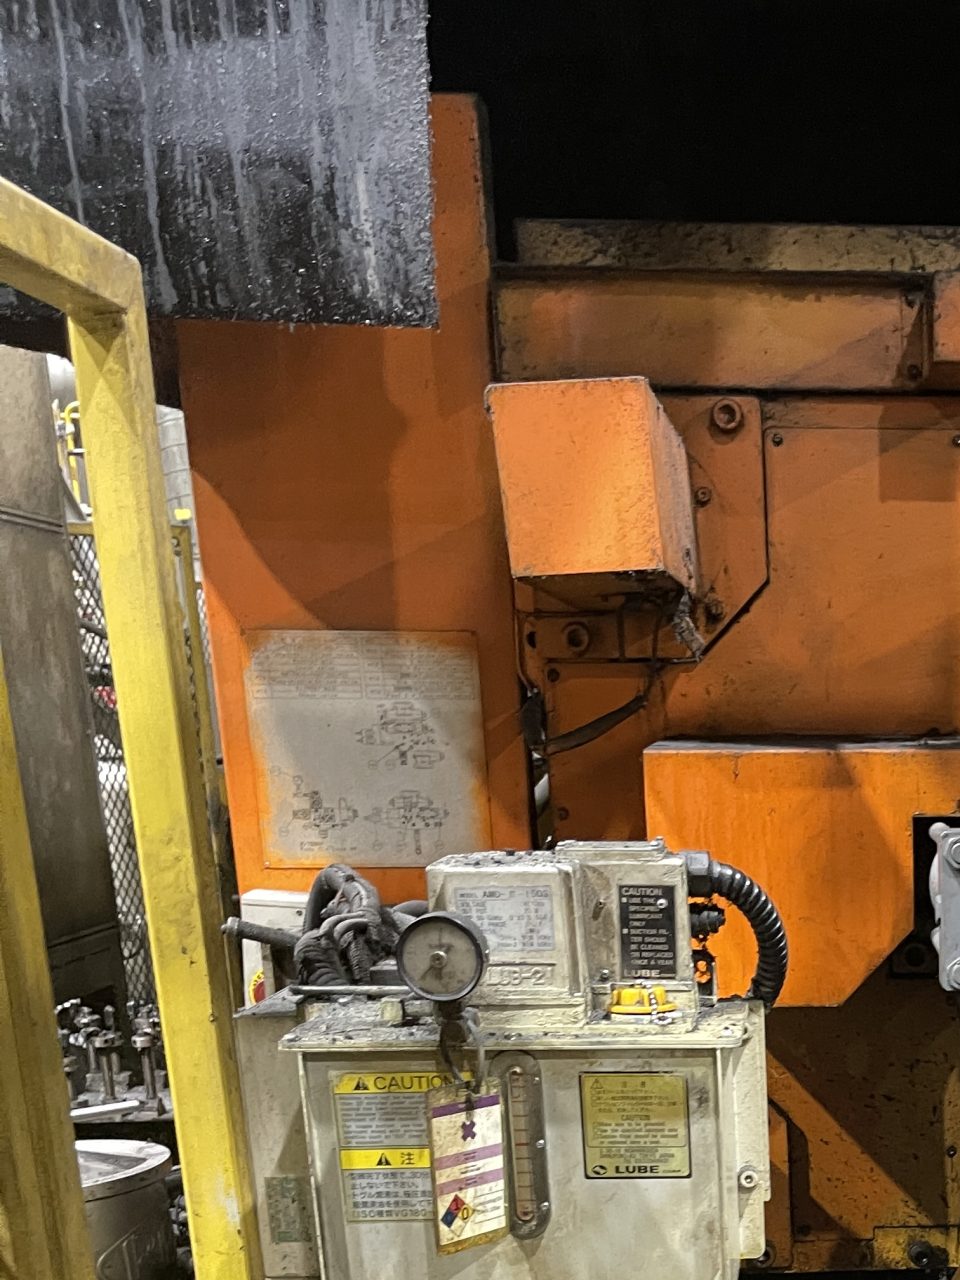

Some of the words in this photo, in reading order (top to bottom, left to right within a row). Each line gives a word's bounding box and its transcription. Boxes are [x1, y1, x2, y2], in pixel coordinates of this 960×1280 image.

[621, 887, 663, 896] CAUTION
[623, 969, 661, 977] LUBE
[400, 1151, 416, 1165] 注
[615, 1166, 660, 1174] LUBE
